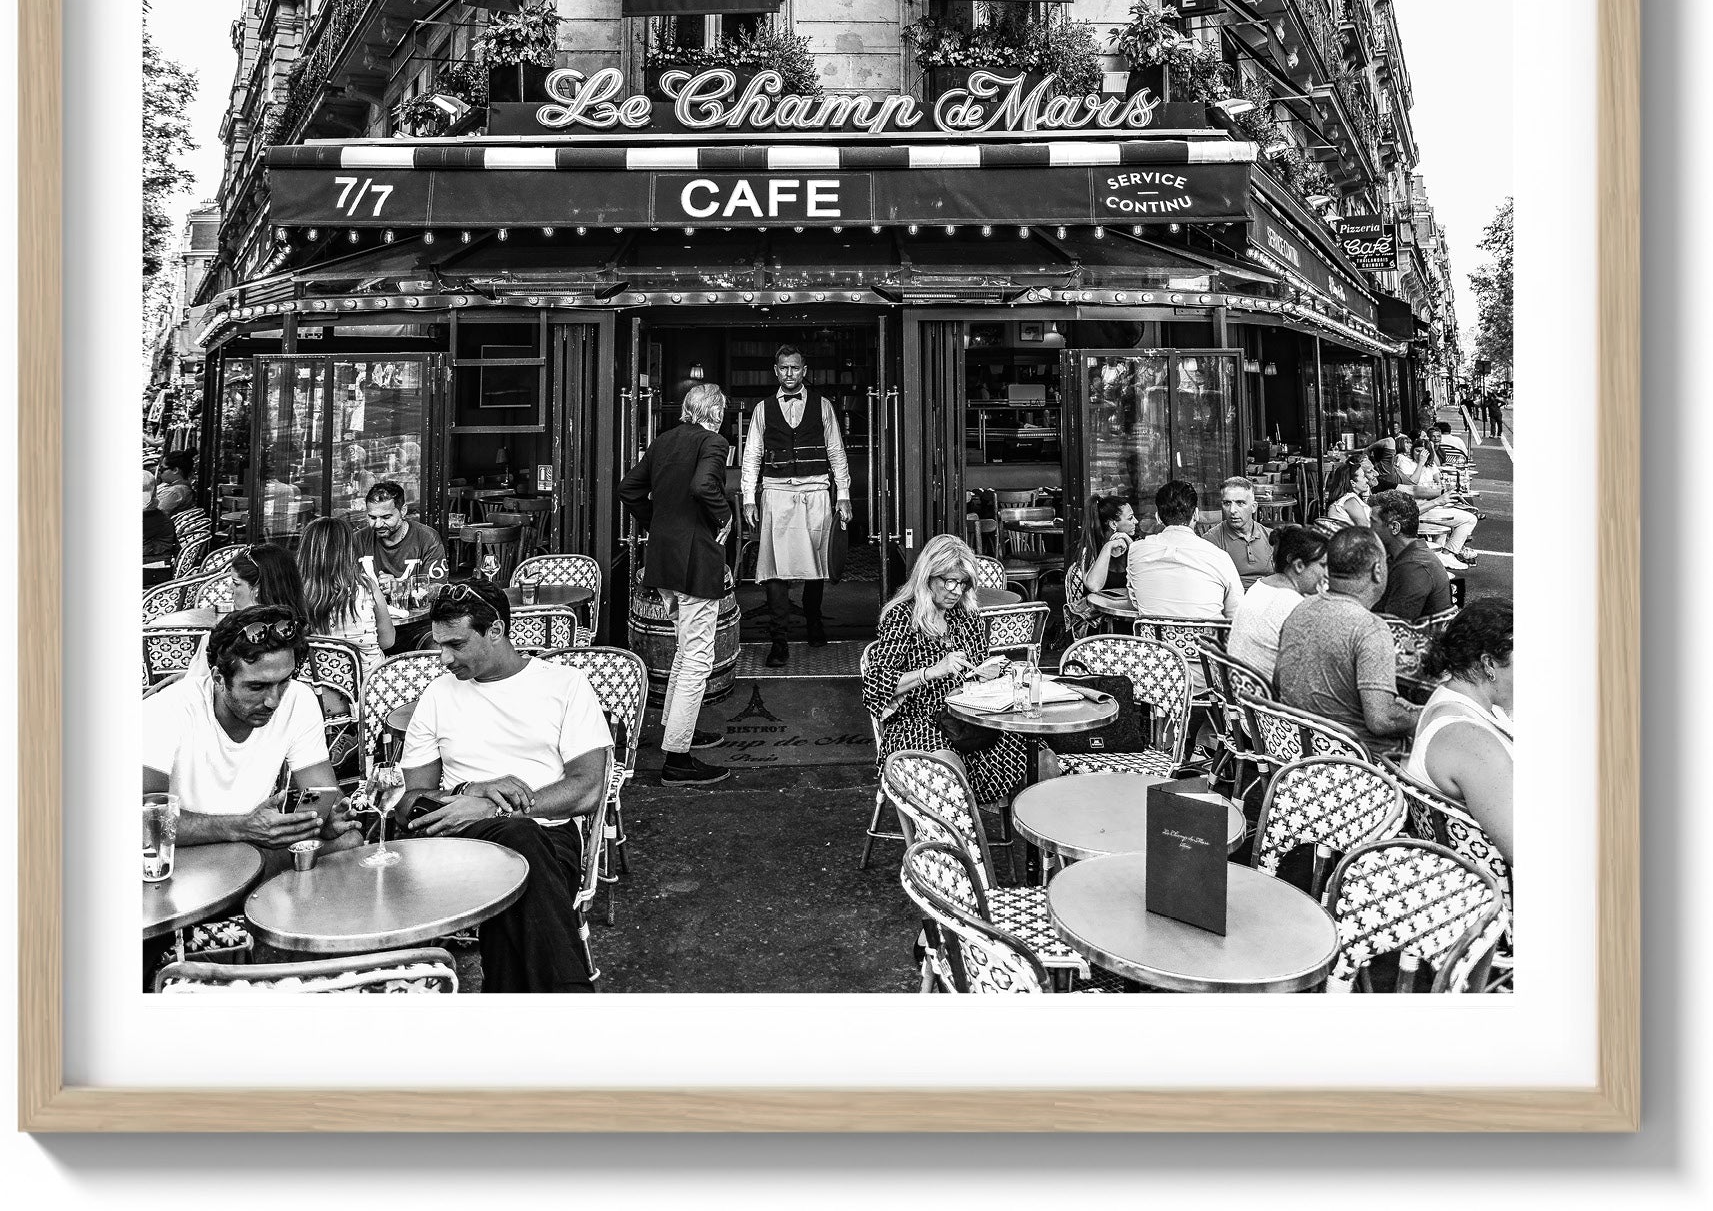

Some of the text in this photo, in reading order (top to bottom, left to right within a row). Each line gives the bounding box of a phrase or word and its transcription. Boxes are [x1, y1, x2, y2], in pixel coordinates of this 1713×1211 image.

[536, 68, 1161, 134] Le Champ de Mars
[1107, 172, 1188, 189] SERVICE
[335, 176, 394, 217] 7/7
[681, 178, 841, 218] CAFE
[1106, 195, 1192, 213] CONTINU
[1340, 223, 1380, 234] Pizzeria
[1343, 234, 1393, 254] Café
[726, 726, 788, 735] BISTROT
[773, 736, 808, 747] de
